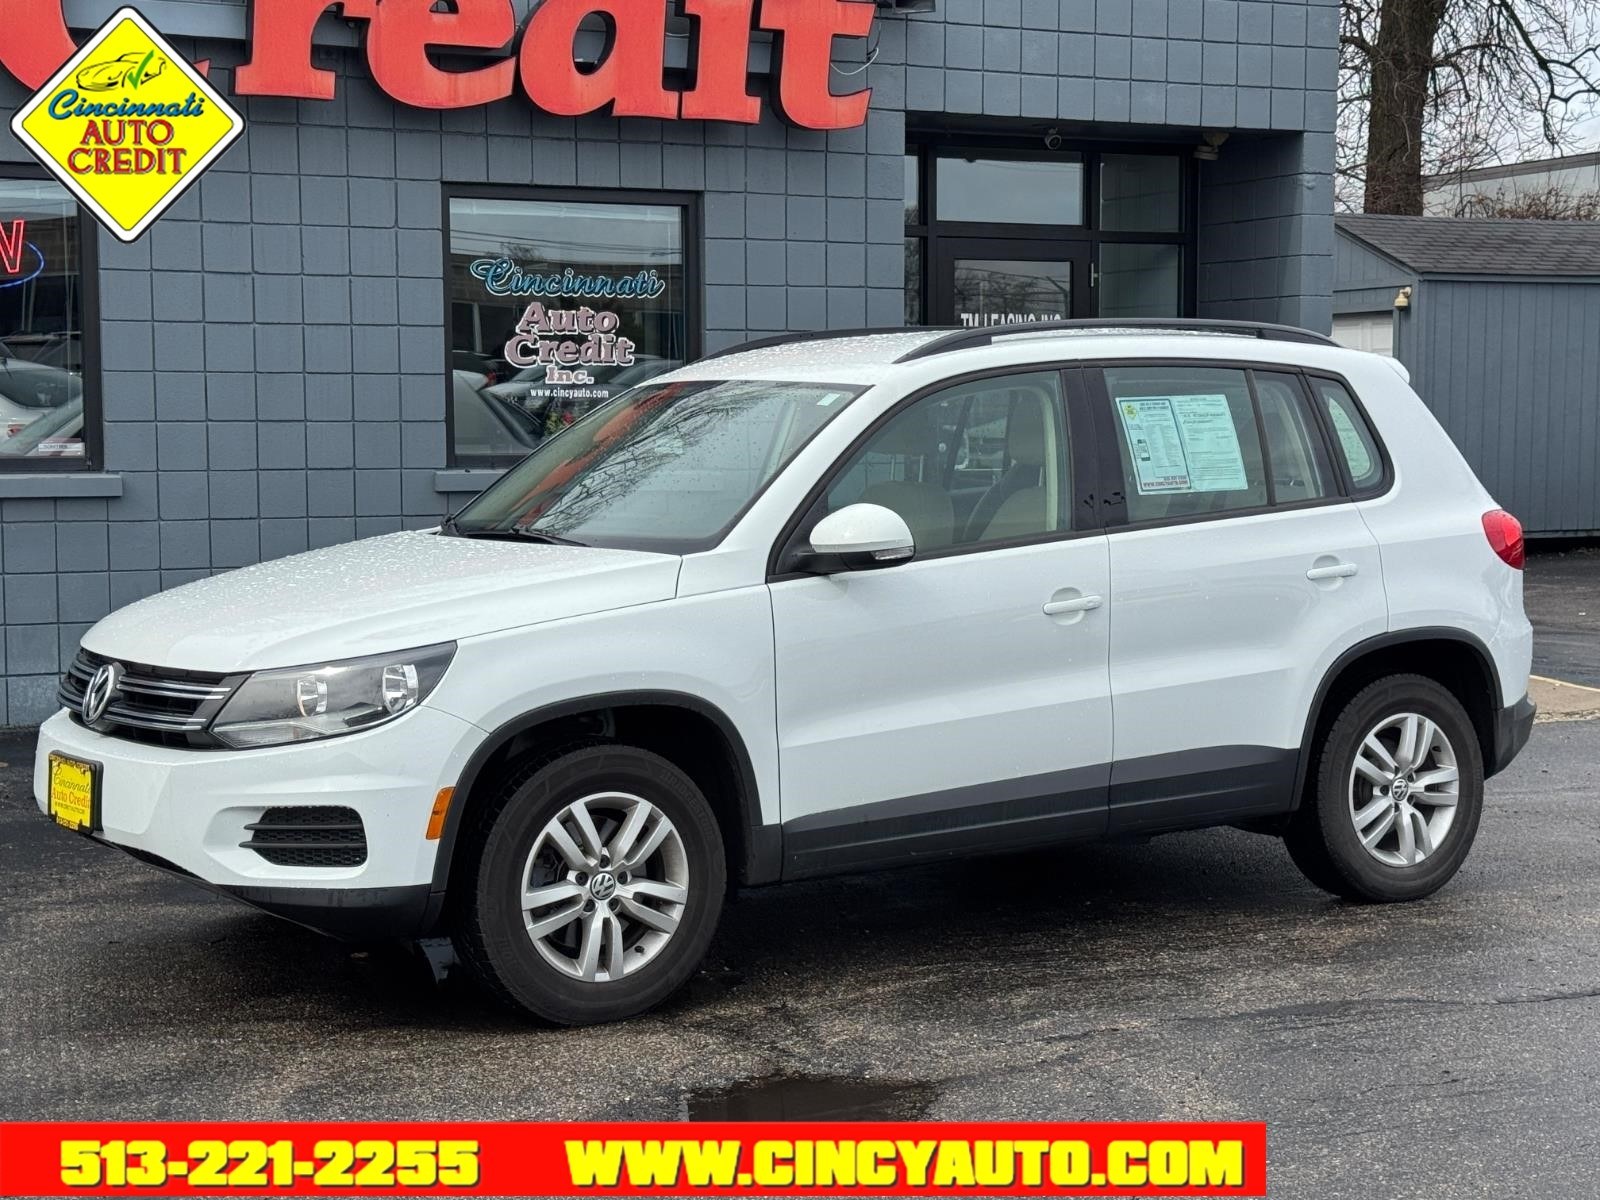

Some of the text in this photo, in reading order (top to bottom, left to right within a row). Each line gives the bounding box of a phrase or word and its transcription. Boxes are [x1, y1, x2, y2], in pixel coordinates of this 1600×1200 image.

[470, 257, 665, 298] Cincinnati
[515, 302, 620, 336] Auto
[504, 333, 636, 368] Credit
[545, 366, 595, 385] Inc.
[530, 387, 609, 399] www.cincyauto.com
